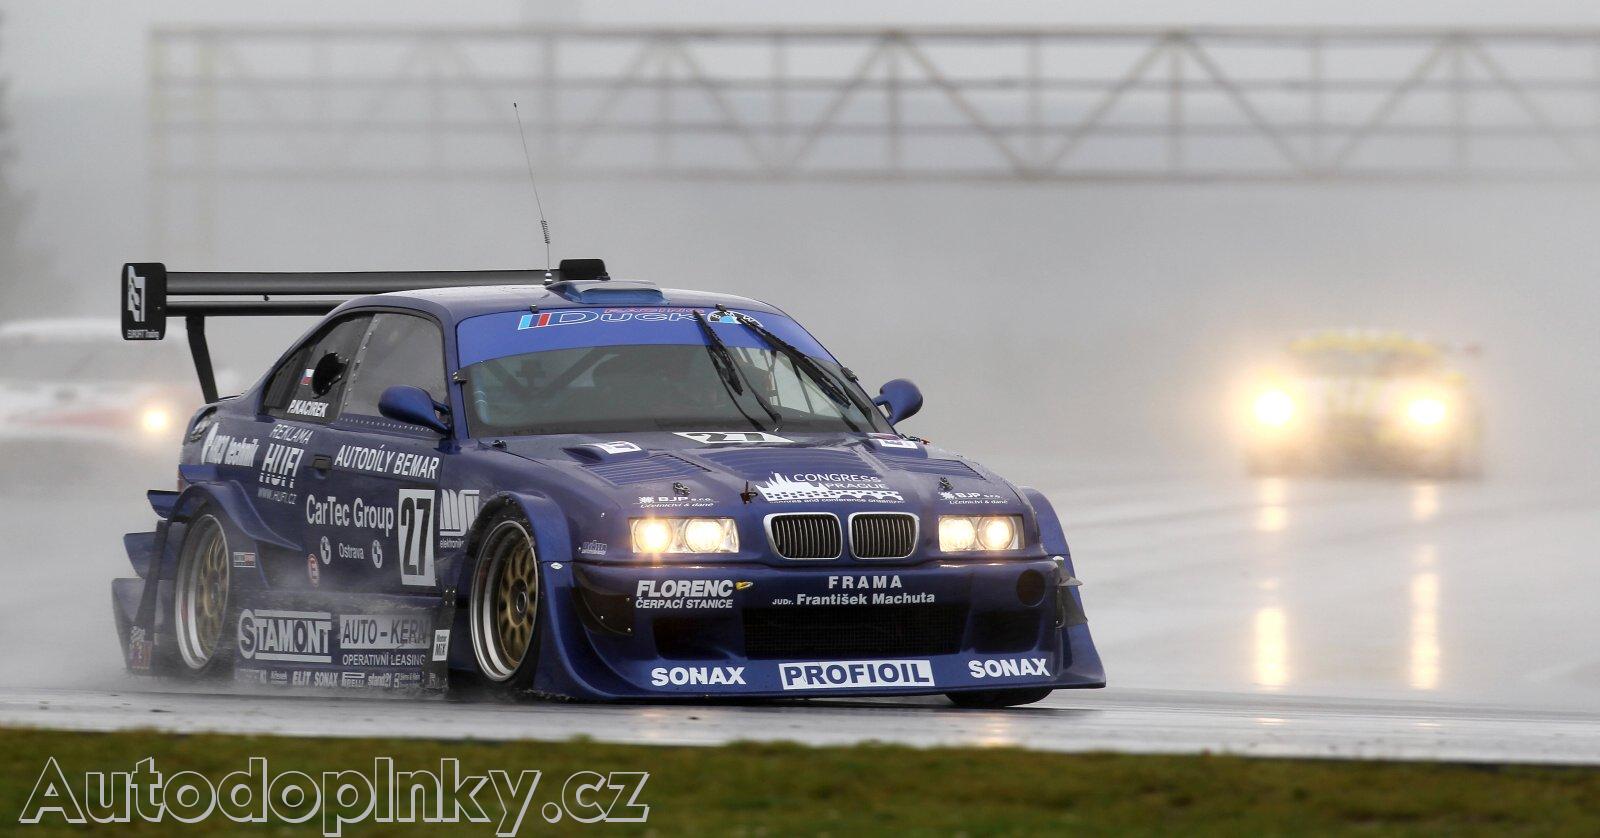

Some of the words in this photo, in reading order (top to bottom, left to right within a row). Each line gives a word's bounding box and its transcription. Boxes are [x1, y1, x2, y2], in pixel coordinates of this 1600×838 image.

[269, 424, 314, 444] REKLAMA
[334, 444, 396, 473] AUTODÍLY
[393, 452, 440, 480] BEMAR
[793, 473, 882, 483] CONGRESS
[306, 493, 350, 527] CarTec
[353, 497, 394, 537] Group
[400, 496, 432, 576] 27
[338, 542, 365, 560] Ostrava
[636, 579, 734, 598] FLORENC
[828, 574, 903, 589] FRAMA
[635, 597, 685, 609] ČERPACÍ
[686, 599, 733, 609] STANICE
[796, 593, 868, 605] František
[872, 591, 935, 605] Machuta
[238, 610, 332, 656] STAMONT
[342, 619, 378, 645] AUTO
[342, 651, 390, 667] OPERATIVNÍ
[390, 653, 426, 667] LEASING
[968, 657, 1051, 679] SONAX
[314, 671, 339, 688] SONAX
[651, 666, 747, 687] SONAX
[784, 662, 931, 686] PROFIOIL
